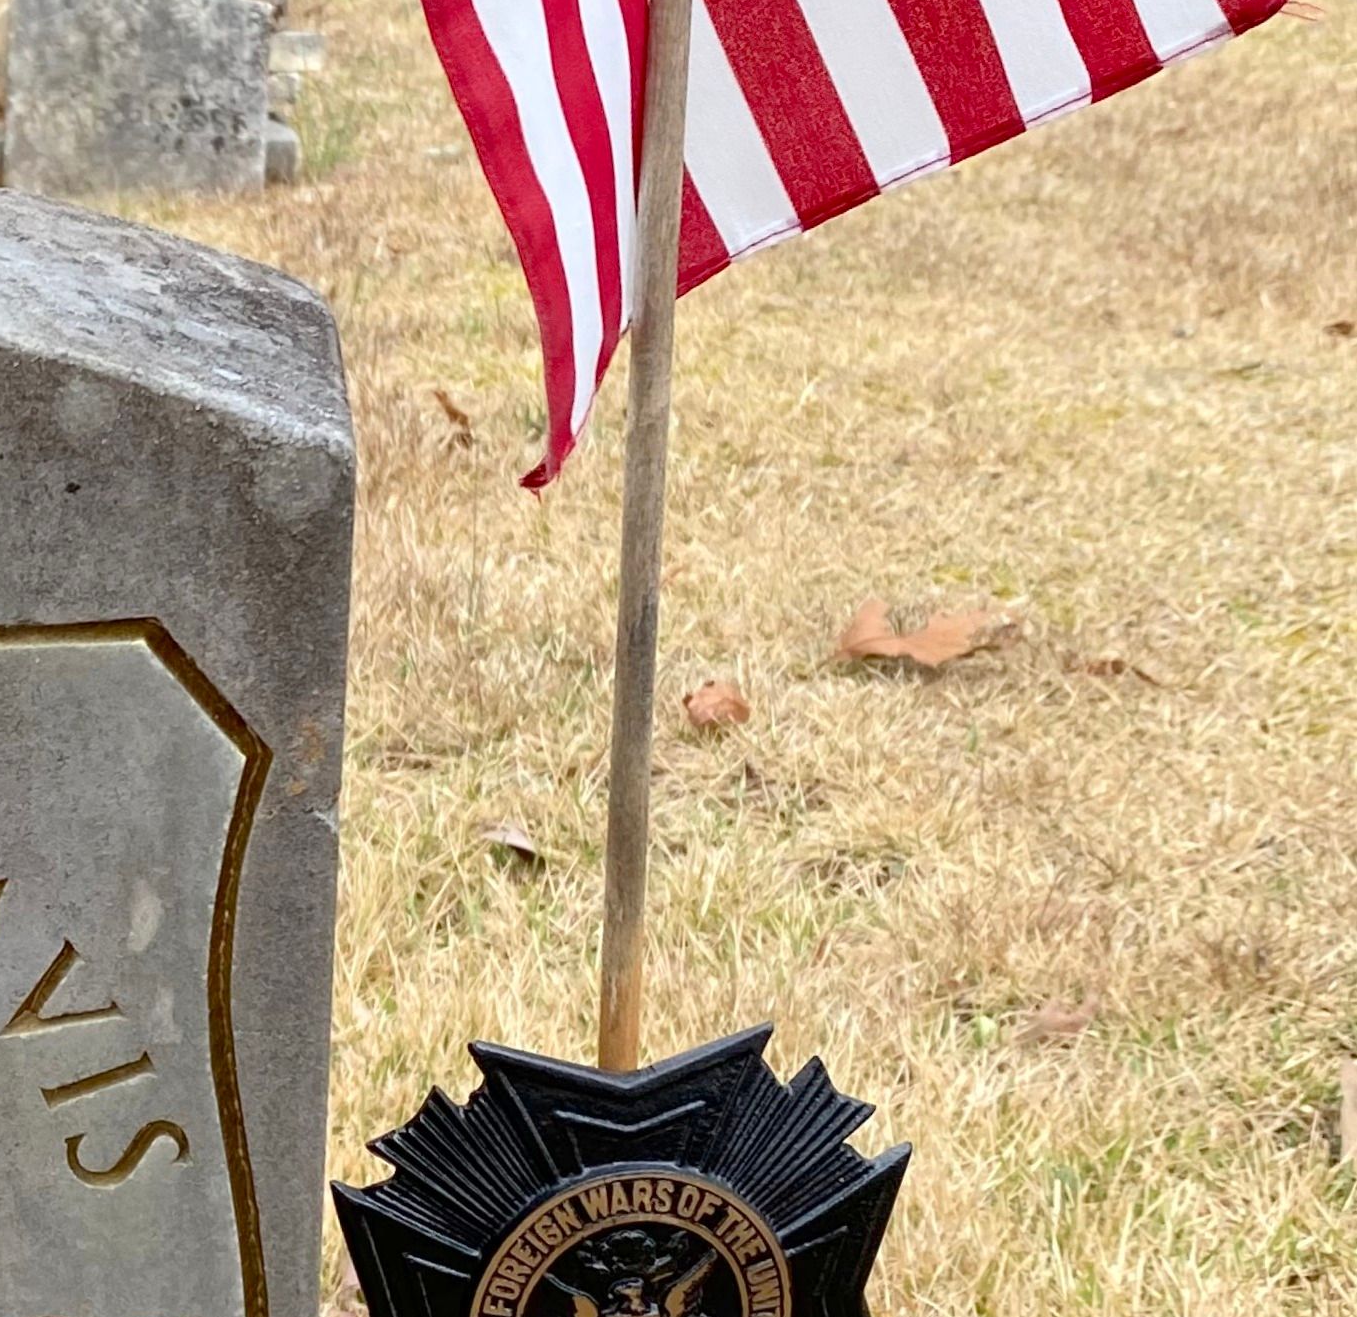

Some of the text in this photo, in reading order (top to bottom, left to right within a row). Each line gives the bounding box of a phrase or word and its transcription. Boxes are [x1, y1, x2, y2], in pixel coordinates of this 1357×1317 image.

[483, 1201, 583, 1317] FOREIGN
[579, 1180, 675, 1218] WARS
[676, 1183, 725, 1222] OF
[716, 1206, 766, 1265] THE
